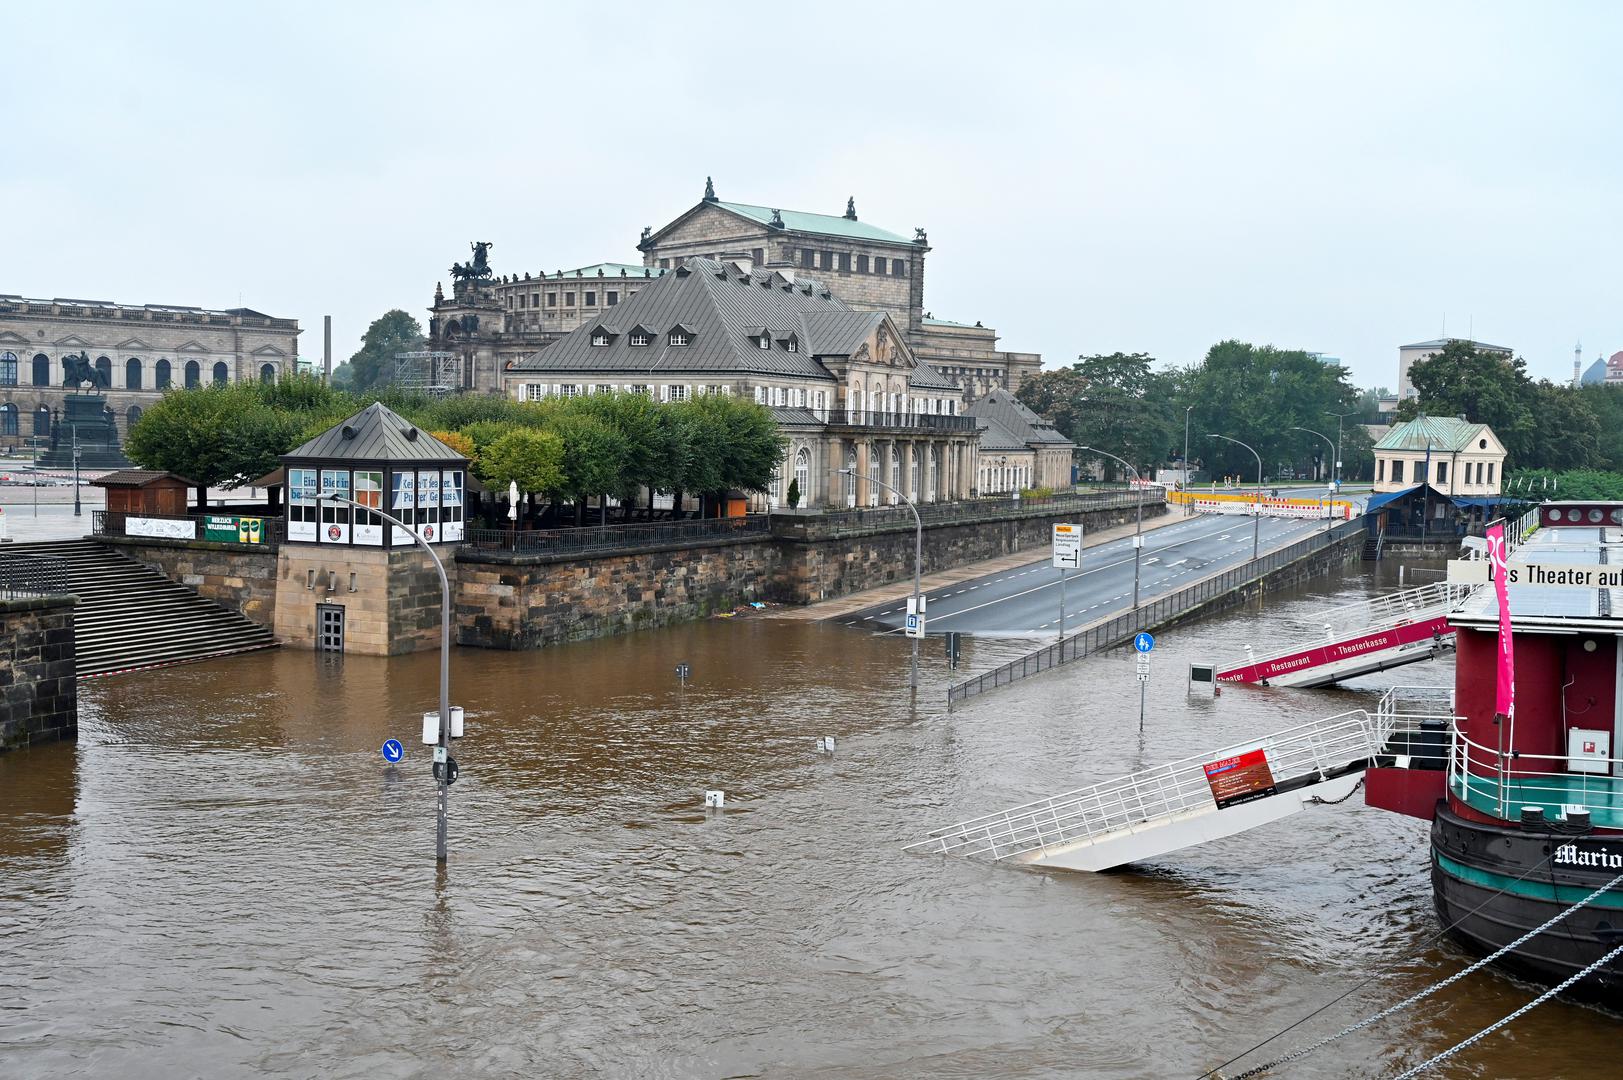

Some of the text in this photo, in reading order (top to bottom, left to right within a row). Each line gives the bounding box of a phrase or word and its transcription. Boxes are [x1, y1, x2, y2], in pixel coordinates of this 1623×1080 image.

[303, 477, 316, 487] Ein
[323, 478, 340, 488] Bier
[1526, 565, 1592, 585] Theater
[1338, 637, 1388, 655] Theaterkasse
[1270, 656, 1310, 672] Restaurant
[1554, 844, 1623, 869] Mario
